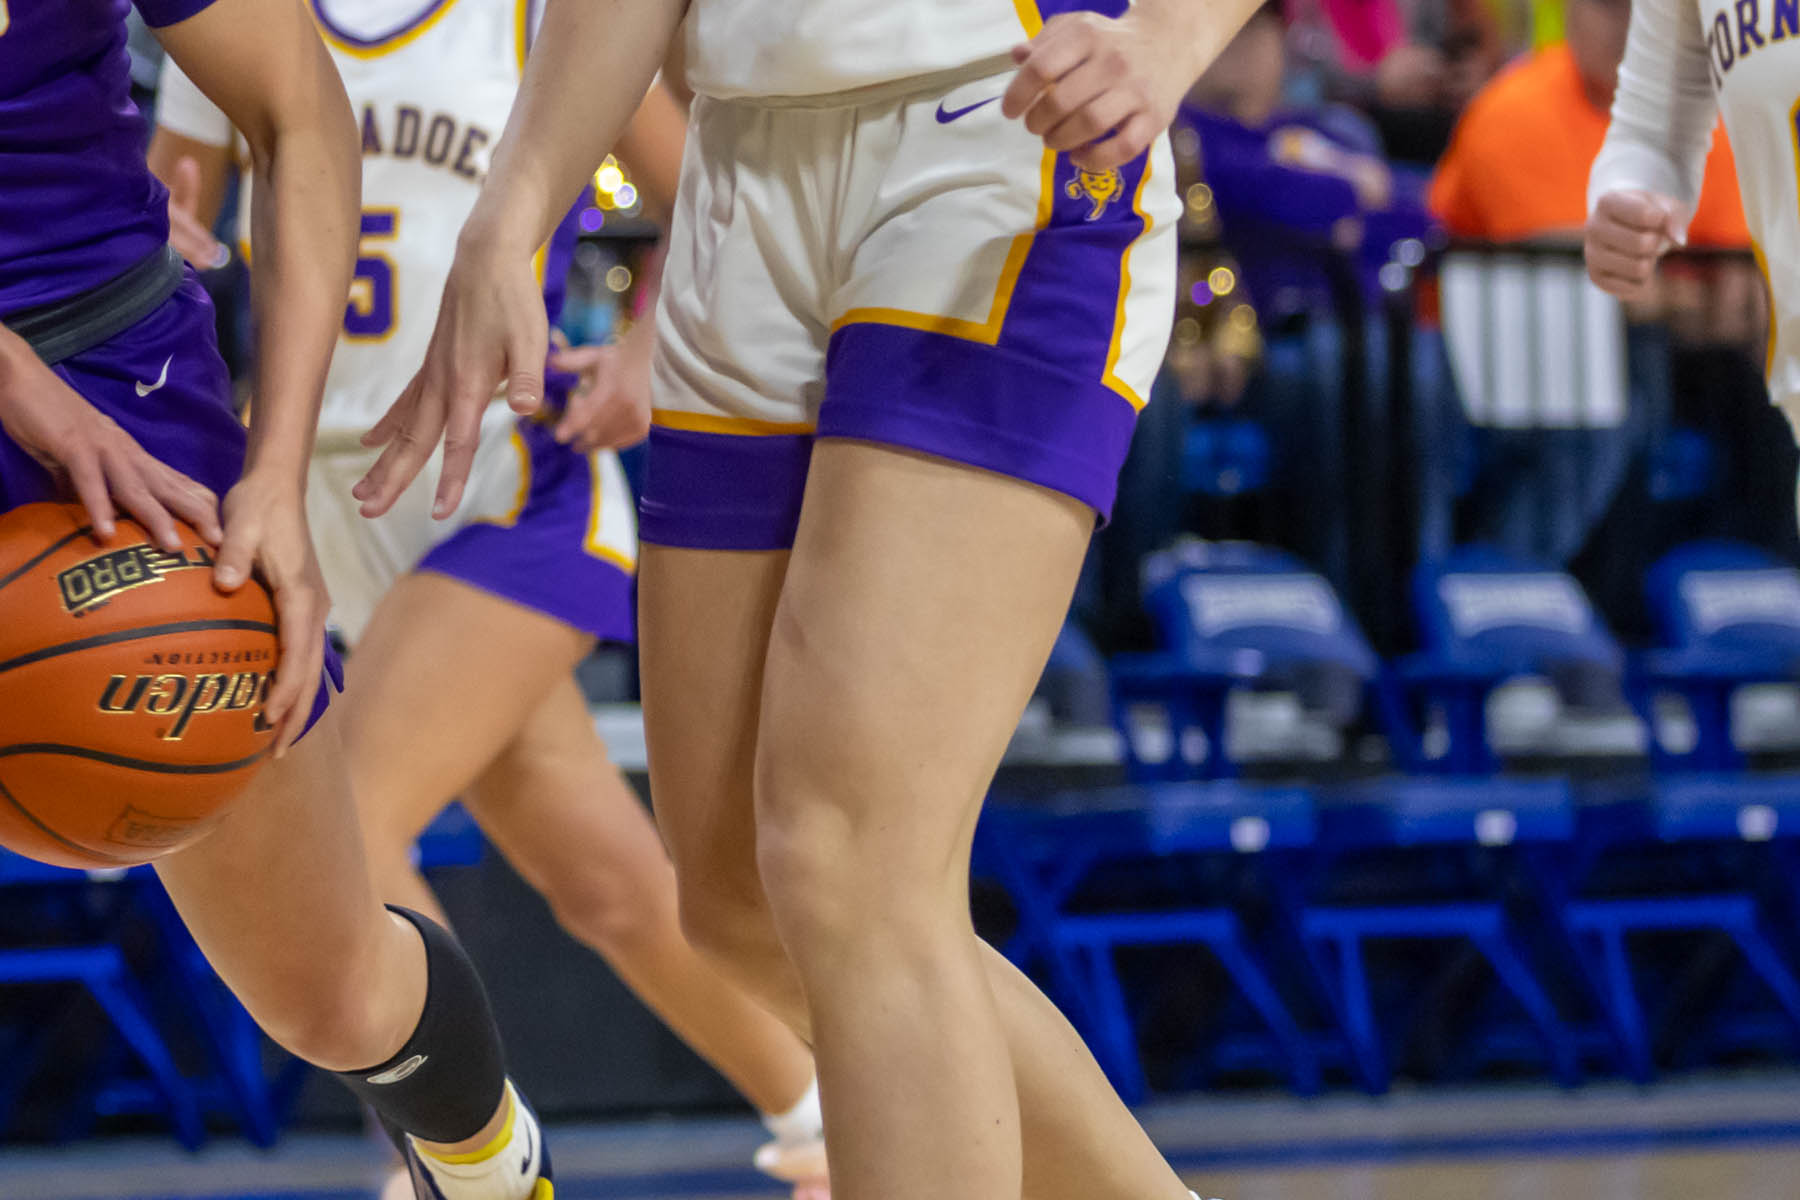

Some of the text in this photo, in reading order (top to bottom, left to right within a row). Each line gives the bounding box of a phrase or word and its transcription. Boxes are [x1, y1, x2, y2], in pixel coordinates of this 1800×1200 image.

[361, 101, 489, 187] ADOE
[342, 205, 401, 345] 5
[62, 551, 144, 604] PRO
